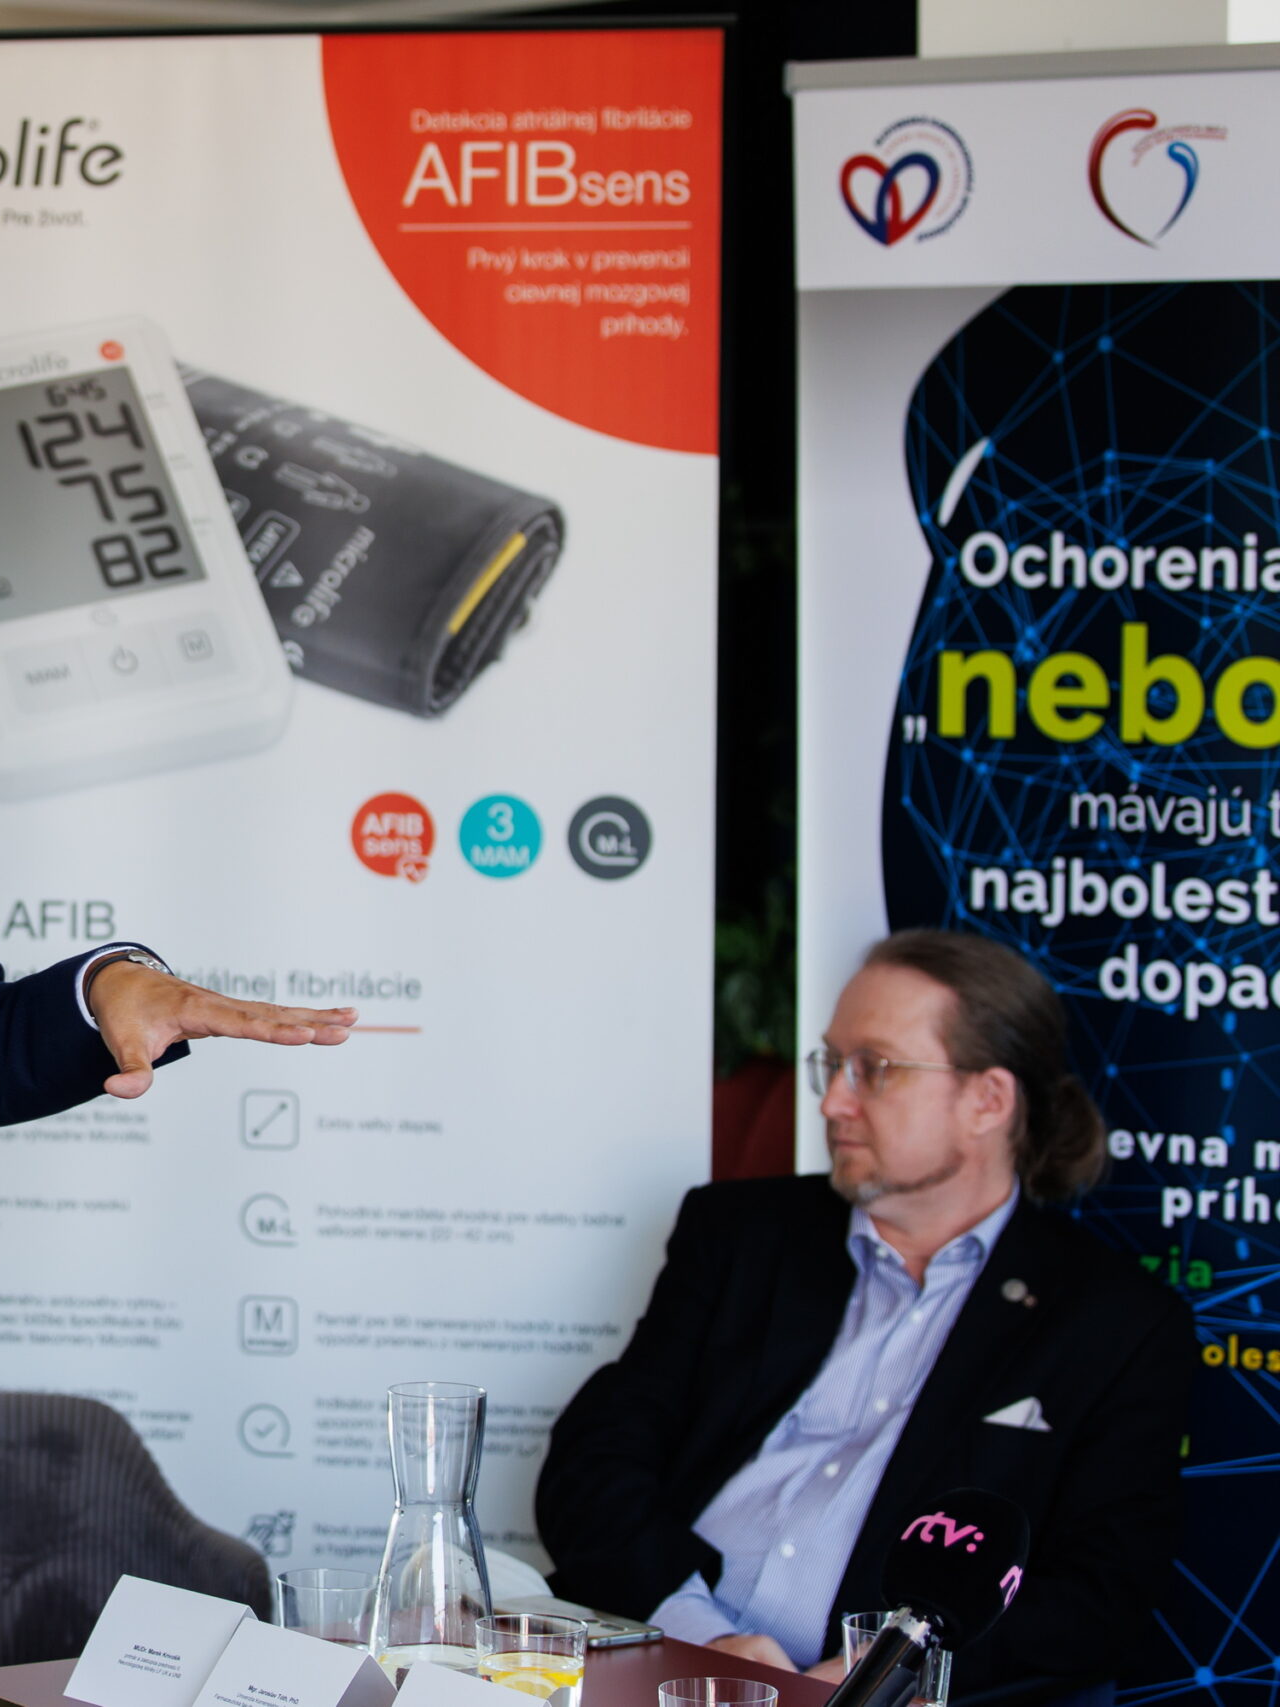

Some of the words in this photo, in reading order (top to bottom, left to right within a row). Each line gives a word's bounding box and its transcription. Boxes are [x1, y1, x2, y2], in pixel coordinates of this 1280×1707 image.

[410, 107, 508, 133] Detekcia
[600, 105, 694, 131] fibrilácie
[467, 246, 517, 275] Prvý
[520, 247, 571, 271] krok
[574, 253, 590, 271] v
[583, 280, 691, 308] mozgovej
[18, 404, 146, 471] 124
[57, 463, 168, 525] 75
[92, 525, 187, 589] 82
[361, 813, 424, 836] AFIB
[486, 802, 515, 842] 3
[1070, 783, 1252, 846] mávajú
[3, 899, 117, 941] AFIB
[287, 967, 422, 1000] fibrilácie
[1099, 944, 1280, 1021] dopa
